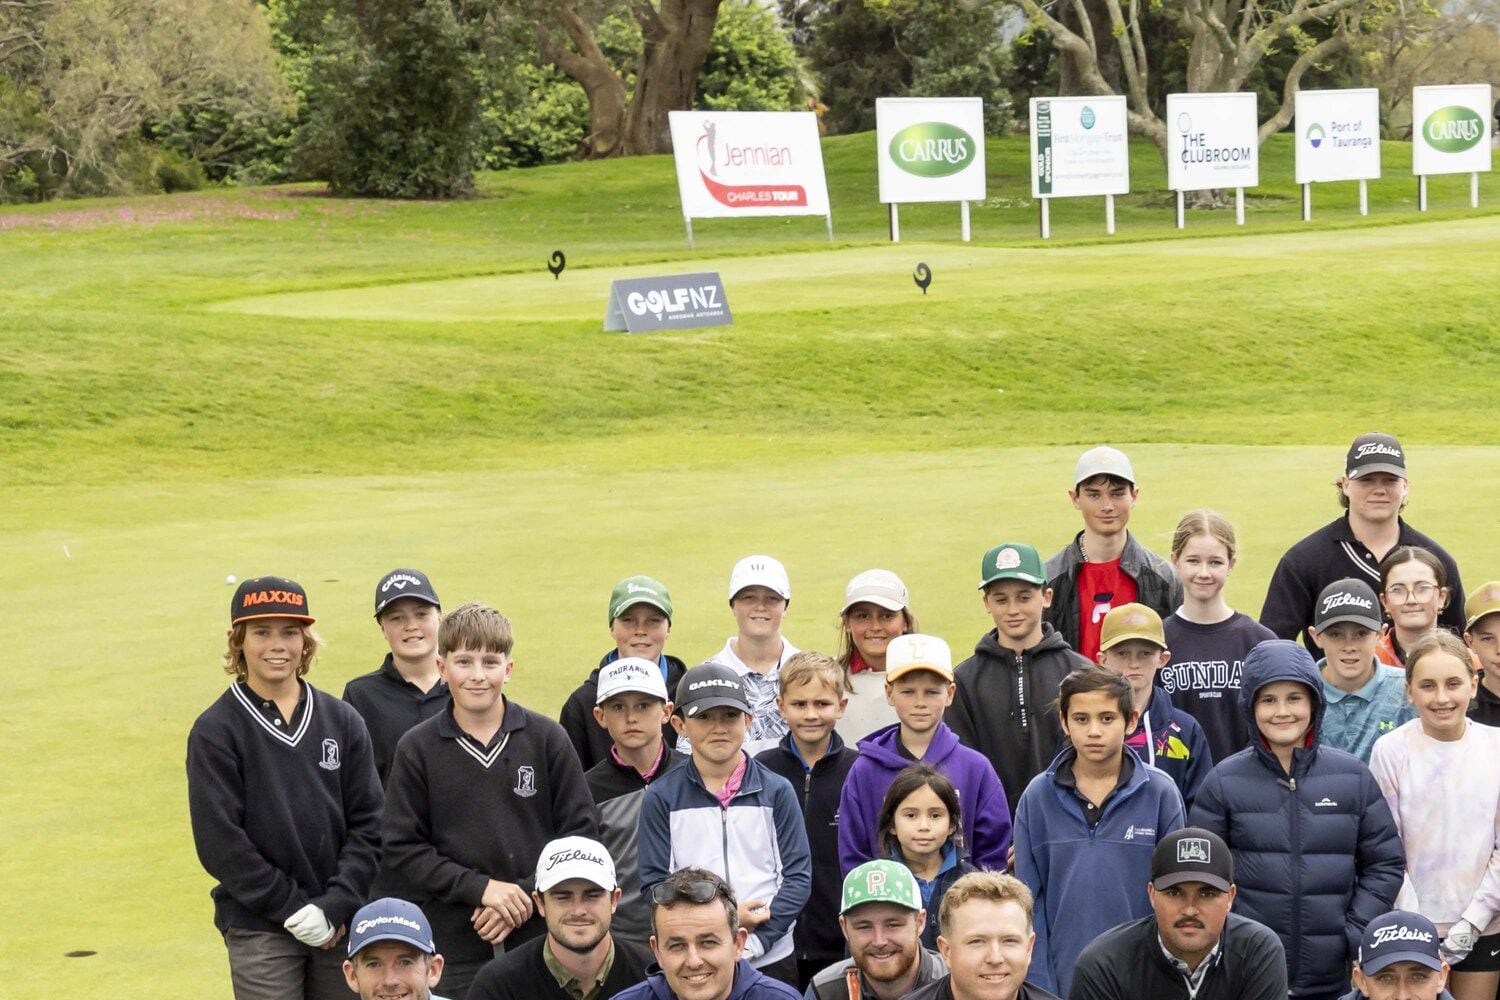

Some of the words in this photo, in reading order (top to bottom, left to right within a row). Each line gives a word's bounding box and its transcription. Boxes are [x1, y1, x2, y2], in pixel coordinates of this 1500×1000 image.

[1331, 121, 1347, 132] Port
[1353, 120, 1363, 131] of
[1428, 118, 1479, 142] CARRUS
[1181, 132, 1206, 147] THE
[1332, 135, 1372, 149] Tauranga
[723, 142, 793, 167] Jennian
[899, 137, 968, 164] CARRUS
[1181, 147, 1251, 164] CLUBROOM
[1355, 442, 1401, 459] Titleist
[382, 573, 421, 593] Callaway
[243, 590, 304, 608] MAXXIS
[1321, 591, 1373, 615] Titleist
[608, 664, 651, 679] TAURANGA
[1161, 660, 1246, 694] SUNDA
[689, 678, 740, 691] OAKLEY
[547, 848, 604, 872] Titleist
[355, 916, 421, 935] TaylorMade
[1370, 924, 1433, 949] Titleist
